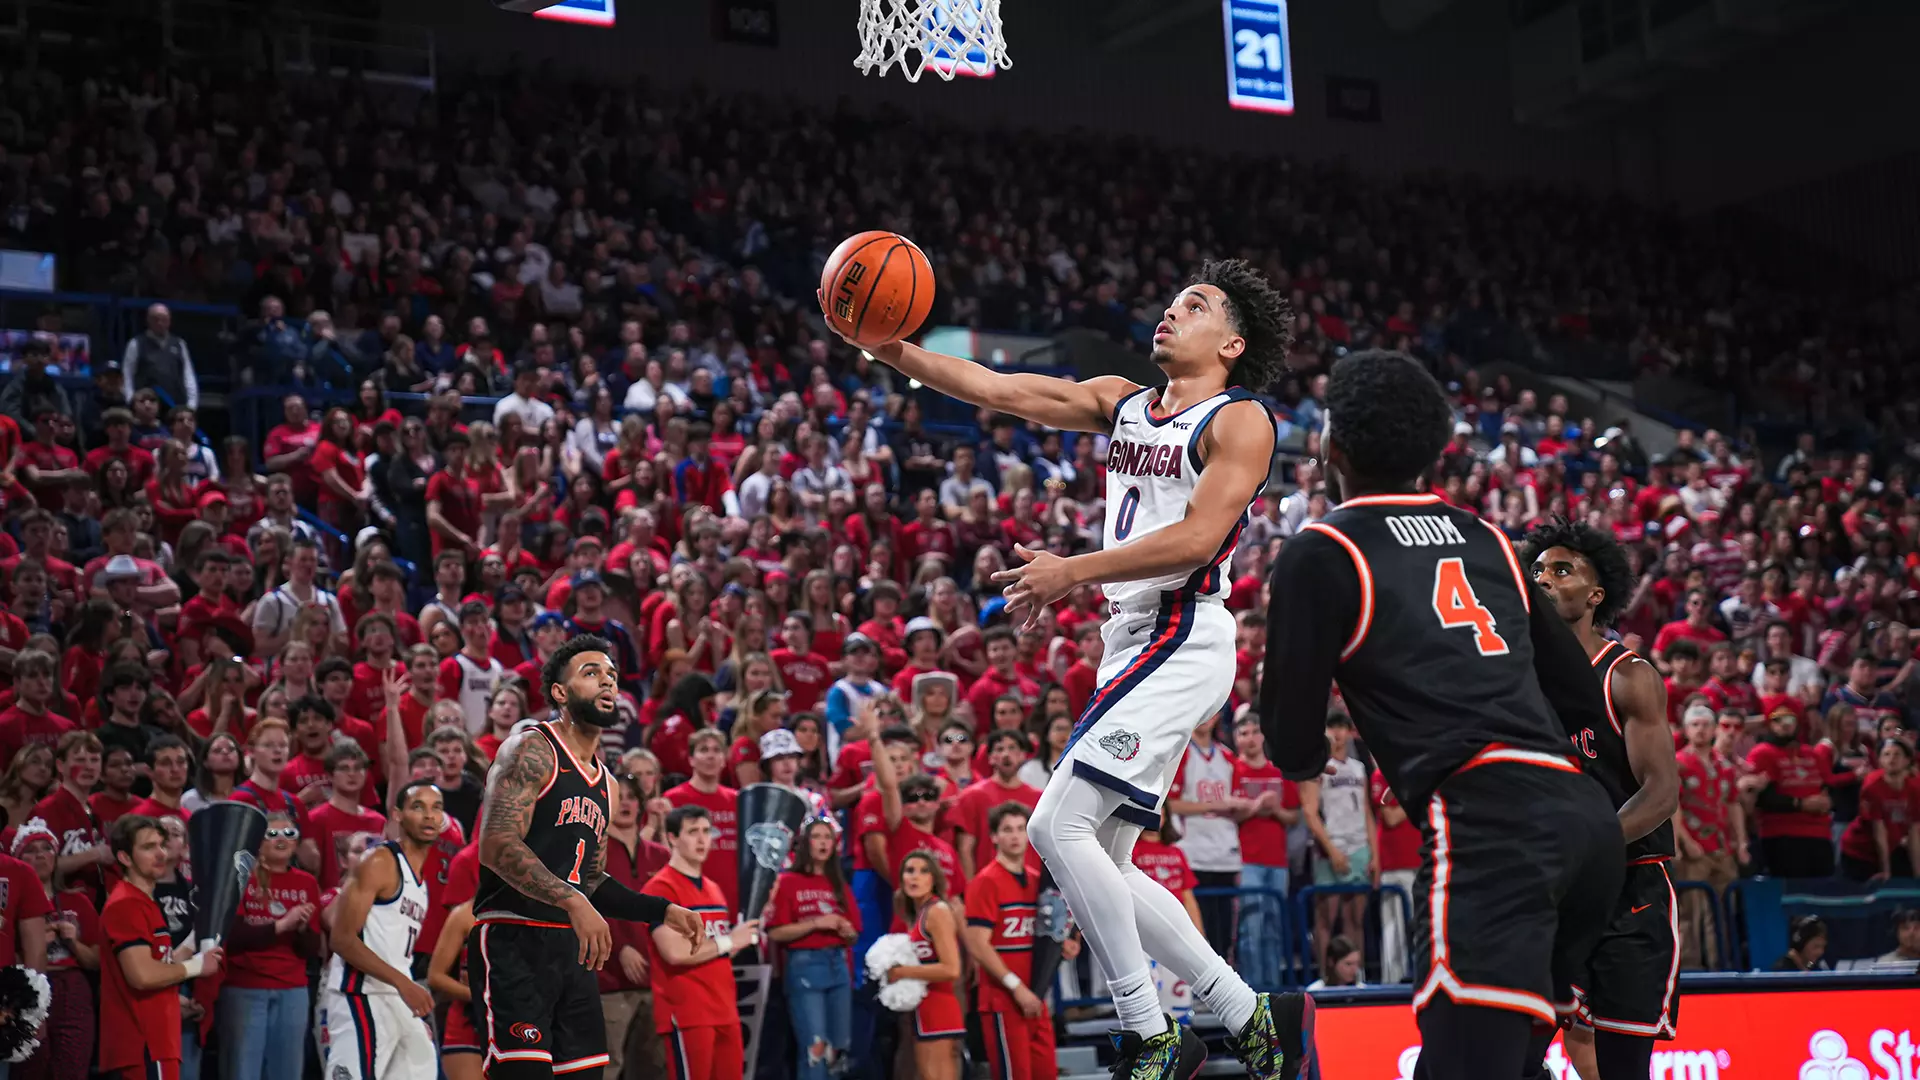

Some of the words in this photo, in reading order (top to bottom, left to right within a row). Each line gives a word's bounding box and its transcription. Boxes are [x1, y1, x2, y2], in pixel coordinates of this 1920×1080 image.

[1234, 28, 1282, 72] 21
[835, 261, 867, 319] ELITE
[1107, 440, 1184, 479] GONZAGA
[1114, 485, 1141, 542] 0
[1385, 515, 1466, 547] ODUM
[1432, 557, 1510, 656] 4
[567, 838, 586, 885] 1
